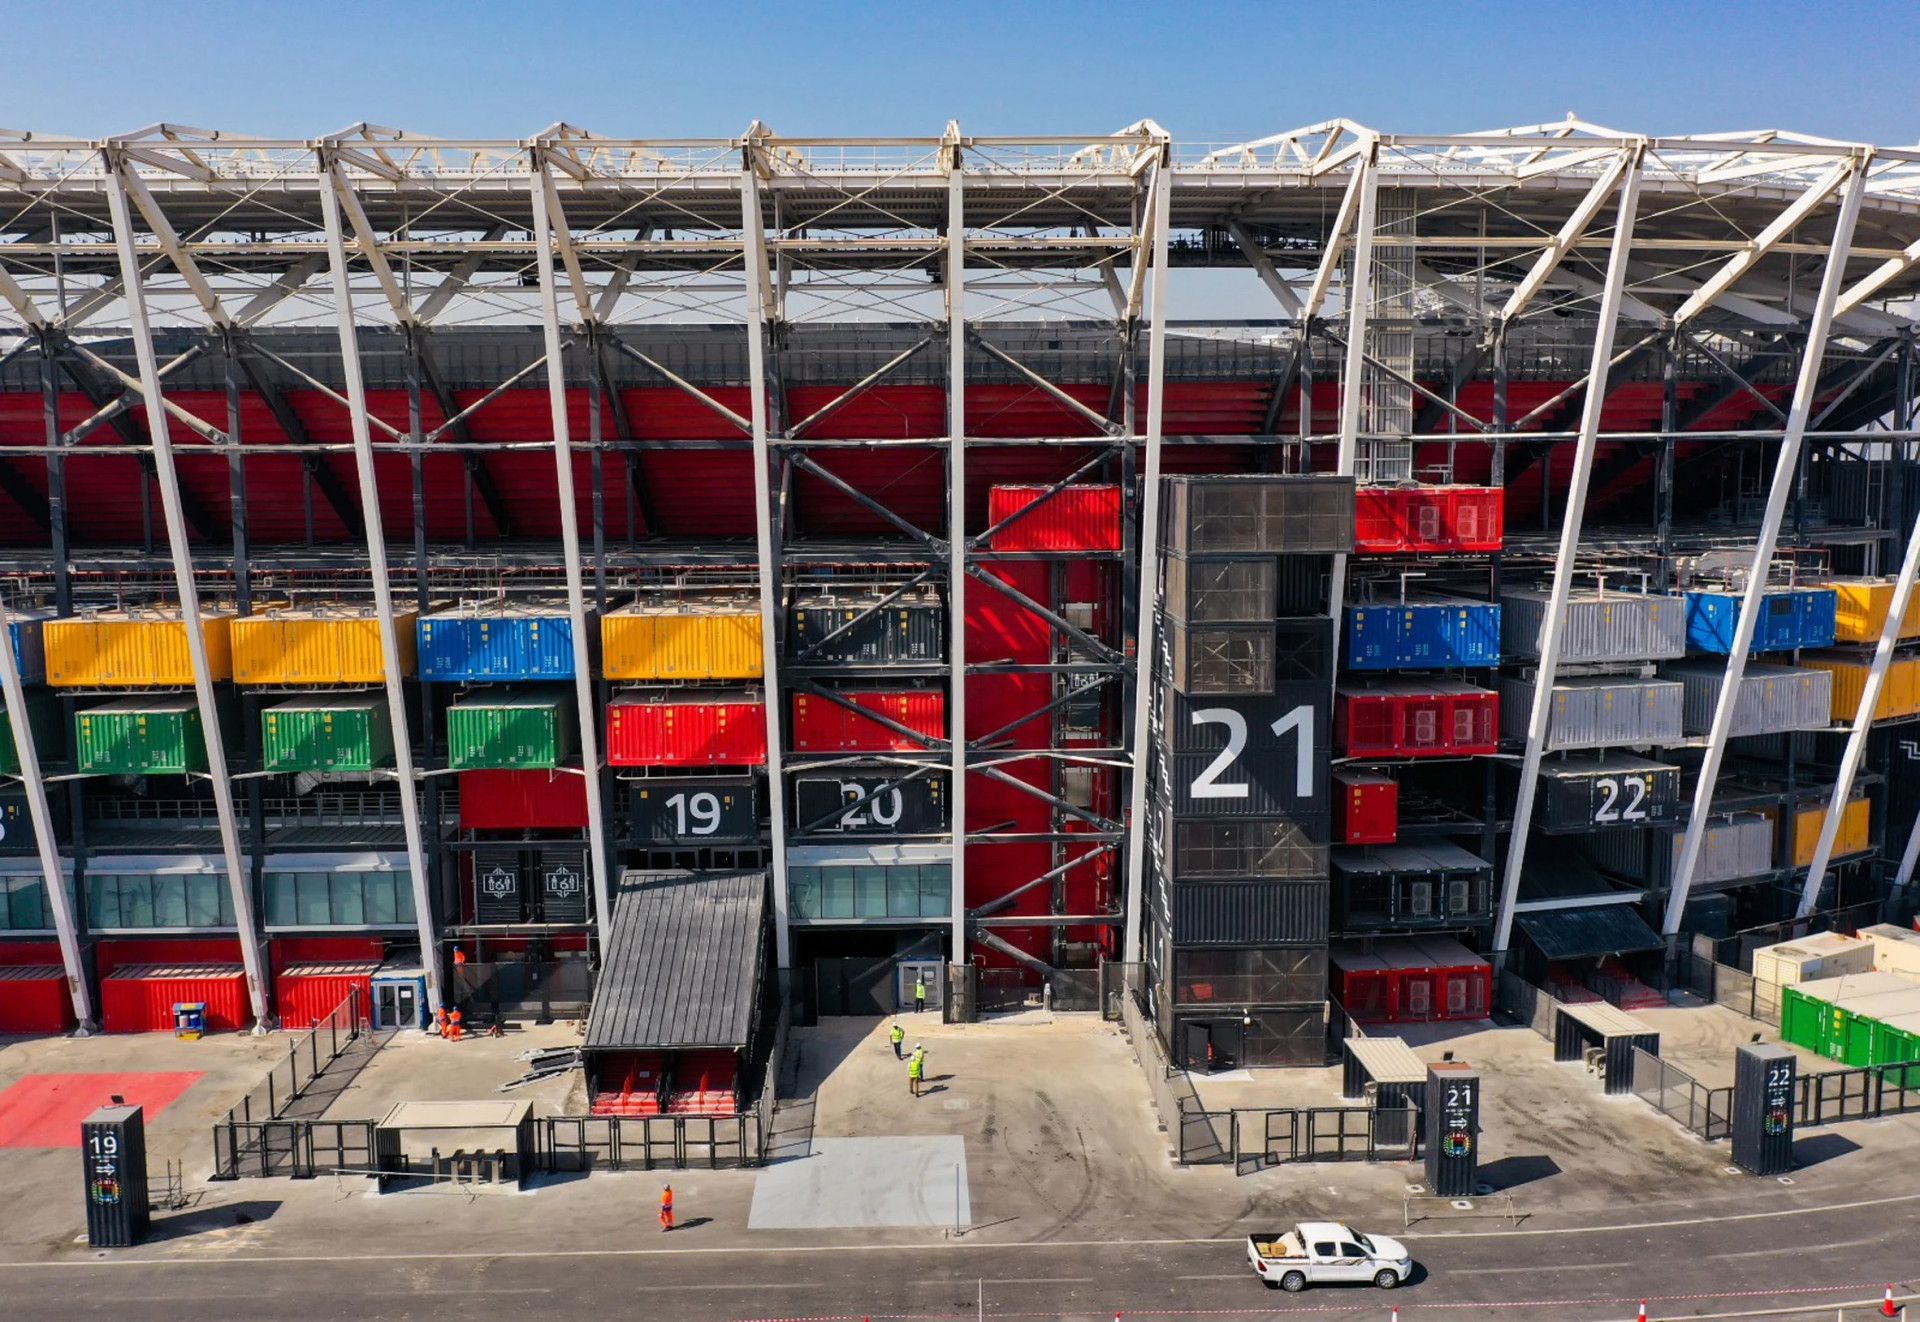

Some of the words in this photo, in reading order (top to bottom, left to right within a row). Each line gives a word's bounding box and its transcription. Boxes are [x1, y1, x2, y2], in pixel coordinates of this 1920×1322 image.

[1190, 704, 1314, 798] 21
[665, 792, 721, 835] 19
[841, 783, 903, 825] 20
[1595, 776, 1646, 821] 22
[1447, 1088, 1471, 1107] 21
[1768, 1068, 1790, 1087] 22
[89, 1136, 117, 1154] 19
